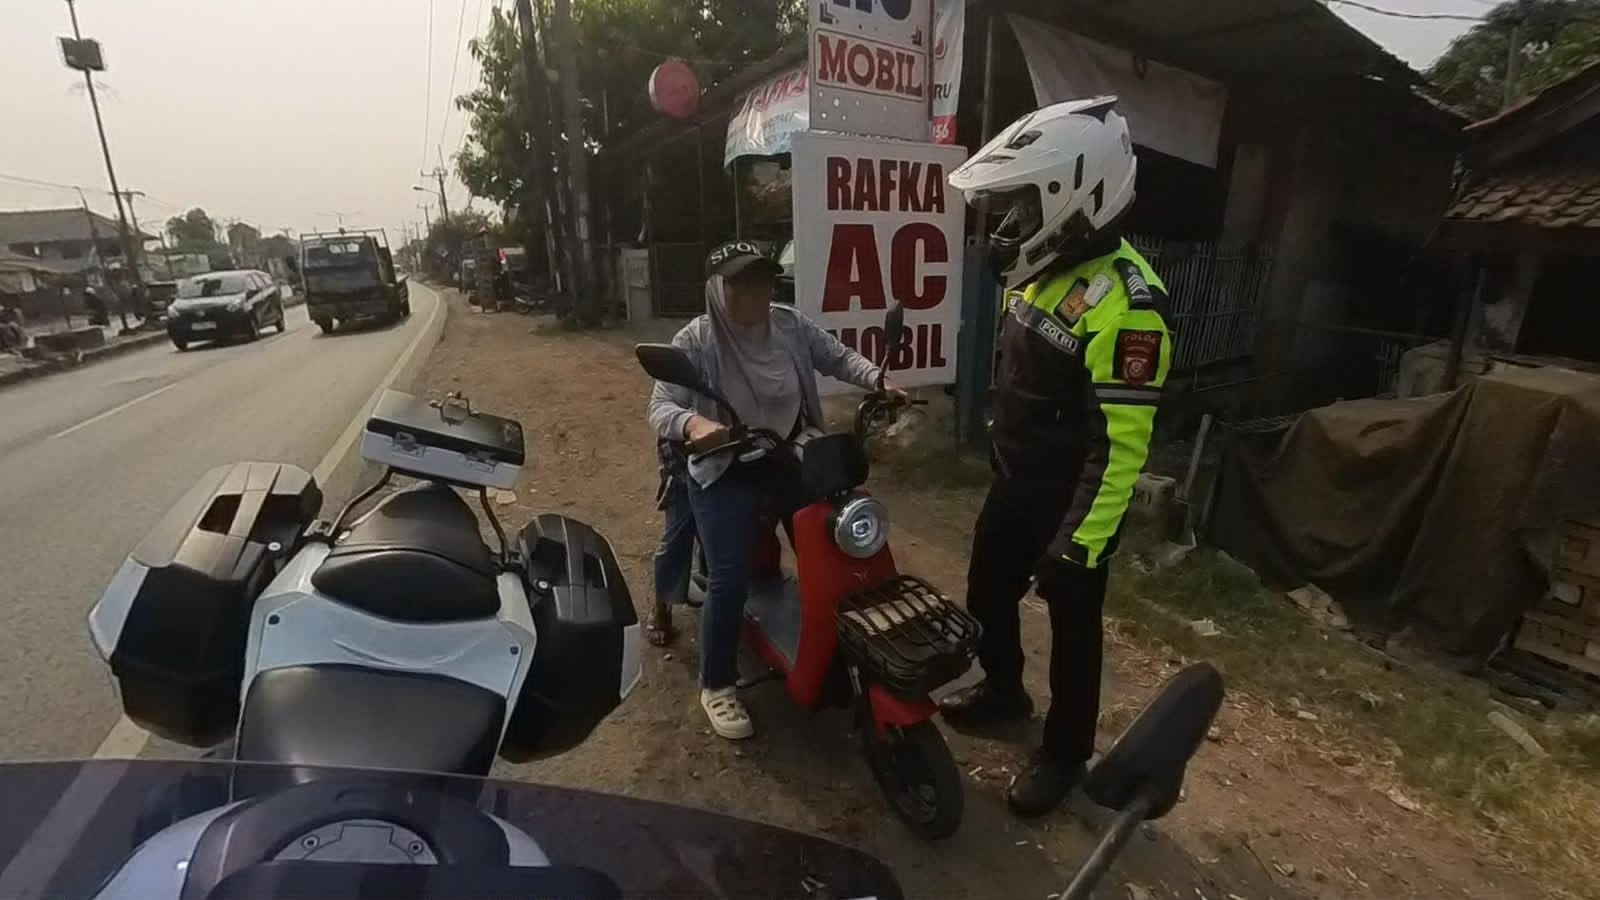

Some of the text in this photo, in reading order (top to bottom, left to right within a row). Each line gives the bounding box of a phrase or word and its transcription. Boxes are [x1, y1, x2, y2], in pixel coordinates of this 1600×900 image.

[818, 34, 922, 98] MOBIL
[827, 157, 945, 213] RAFKA
[821, 222, 948, 312] AC
